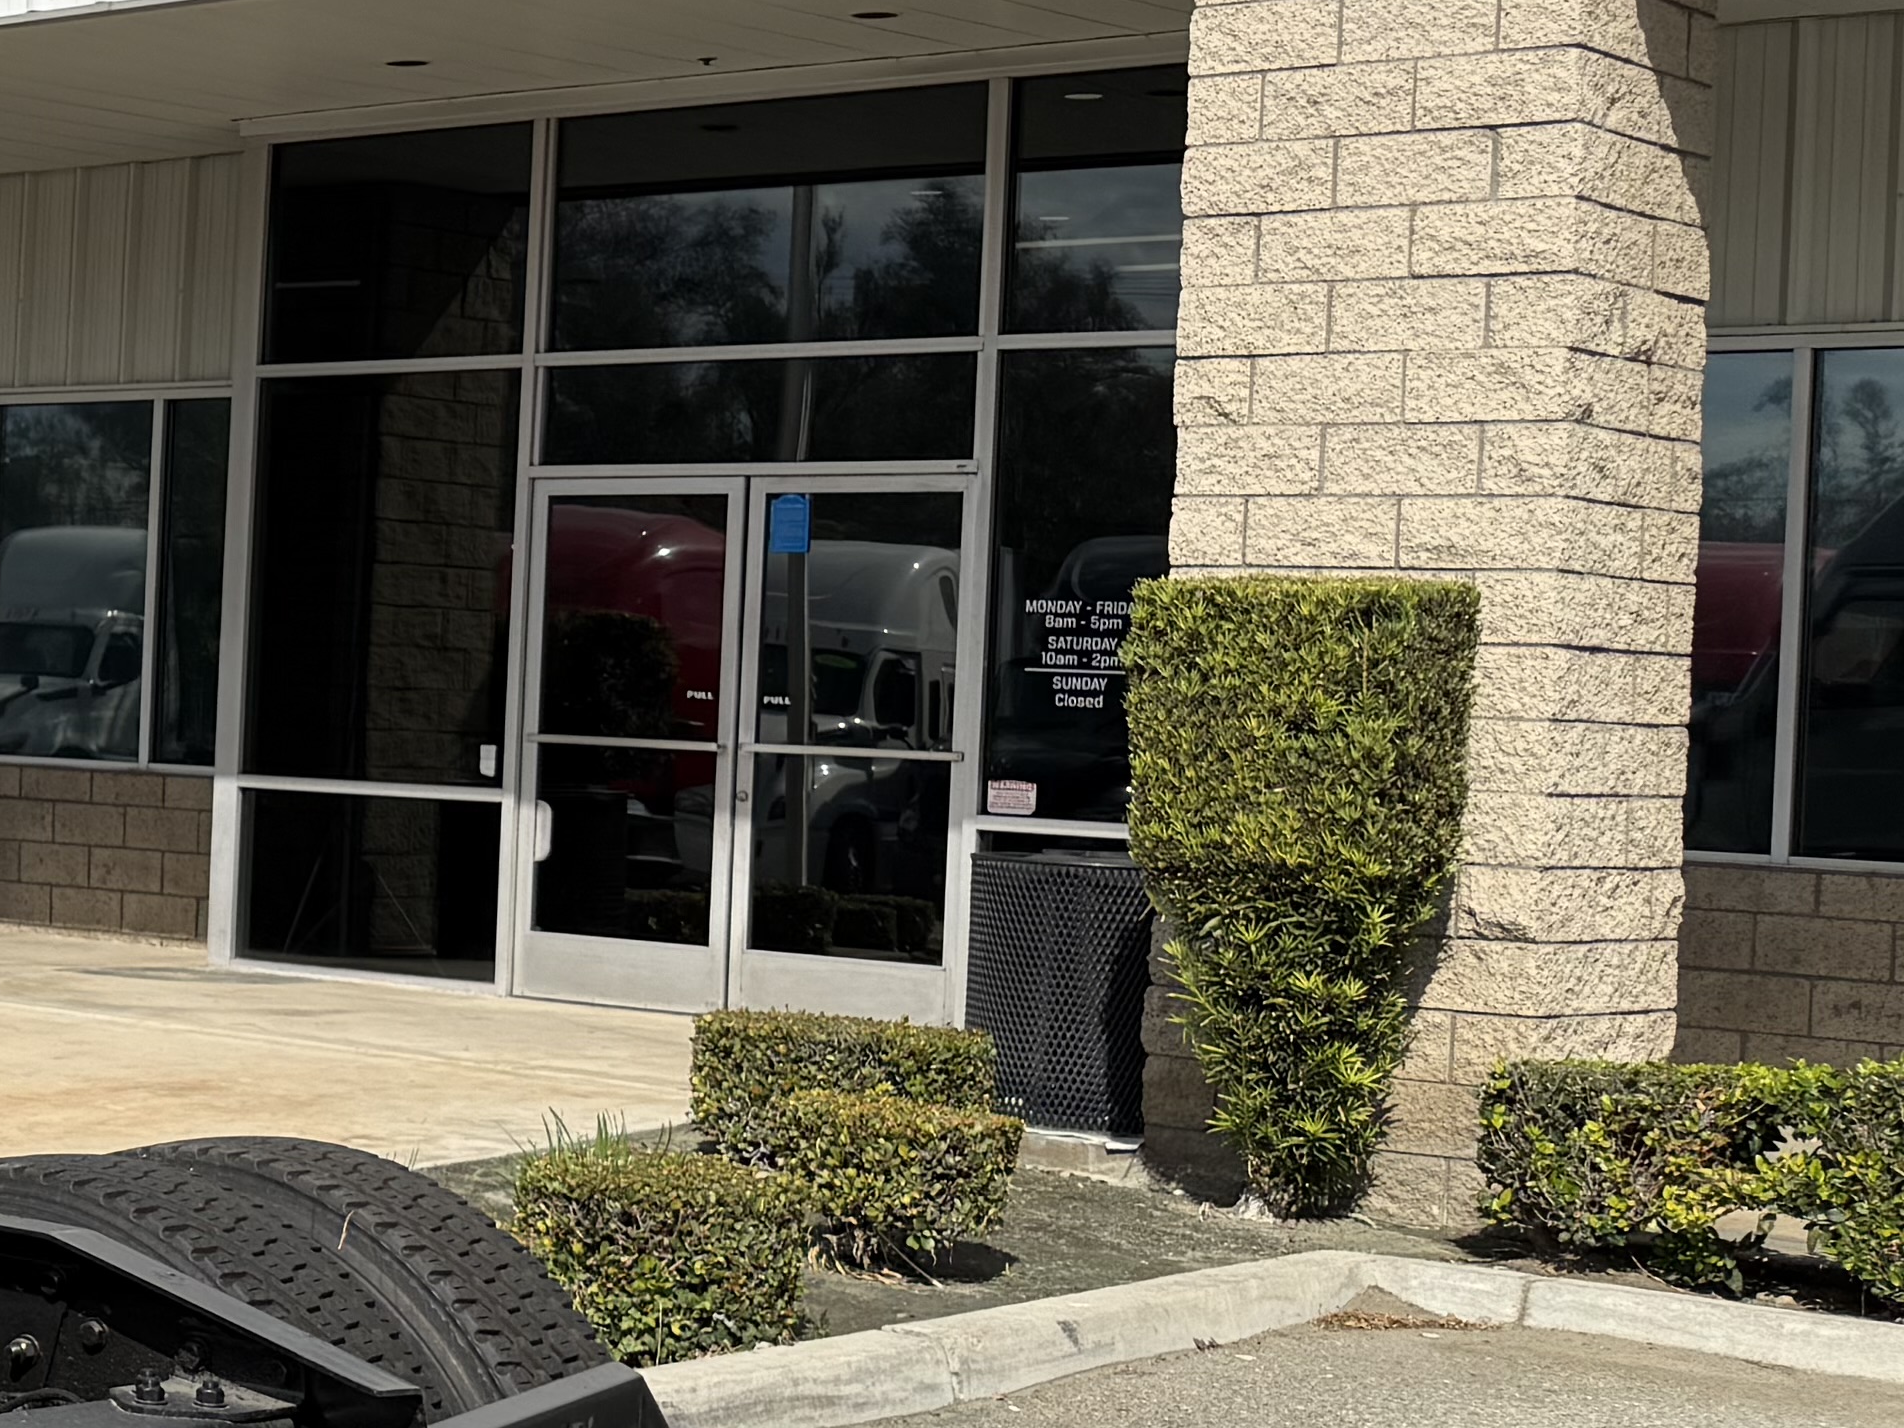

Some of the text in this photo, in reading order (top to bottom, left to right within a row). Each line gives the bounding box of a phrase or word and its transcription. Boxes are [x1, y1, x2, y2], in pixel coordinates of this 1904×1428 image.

[1025, 599, 1083, 614] MONDAY
[1096, 600, 1135, 615] FRIDA
[1045, 614, 1077, 628] 8am
[1090, 615, 1123, 632] 5pm
[1047, 635, 1119, 651] SATURDAY
[1041, 651, 1078, 666] 10am
[1052, 675, 1108, 692] SUNDAY
[687, 690, 714, 701] PULL
[763, 696, 791, 705] PULL
[1055, 692, 1104, 709] Closed
